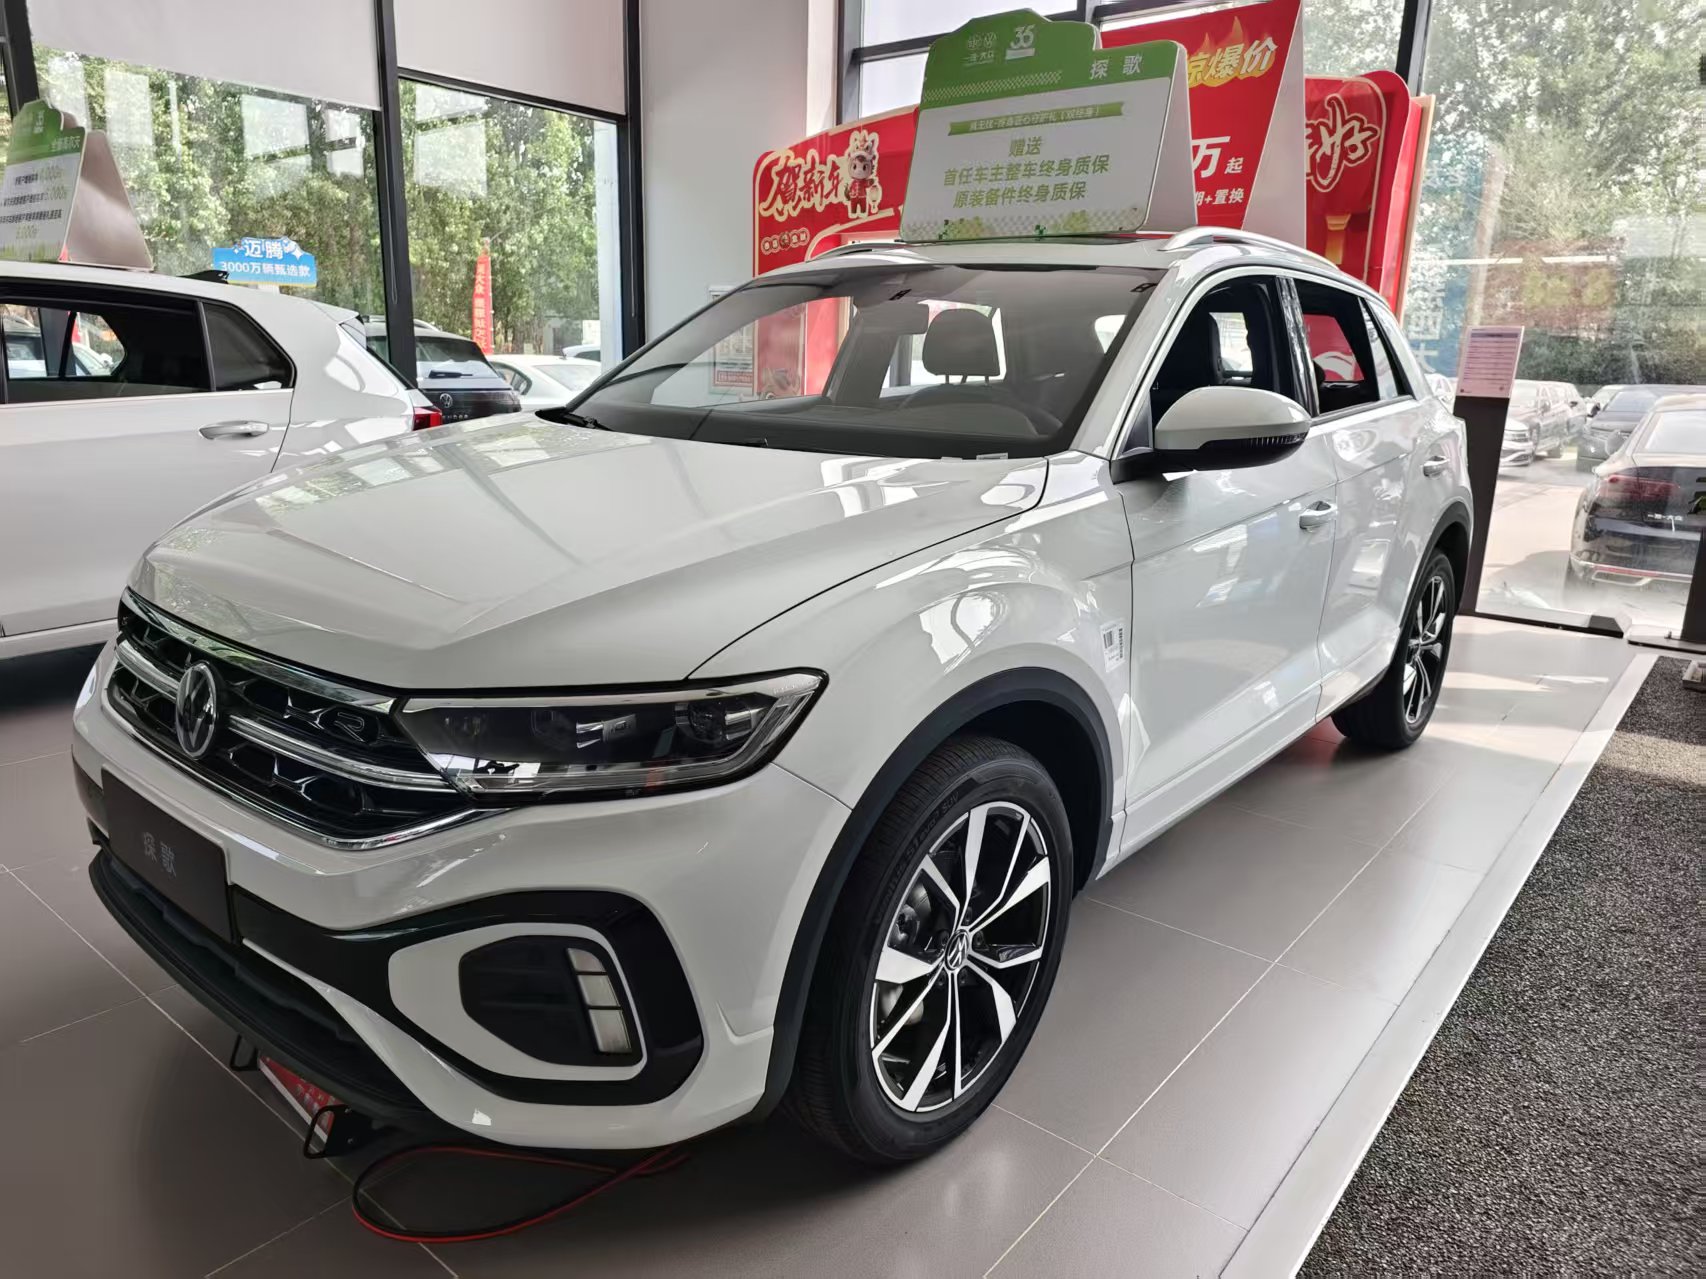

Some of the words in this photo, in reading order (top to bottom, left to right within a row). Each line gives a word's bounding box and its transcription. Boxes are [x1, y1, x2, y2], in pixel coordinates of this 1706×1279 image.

[1090, 54, 1143, 80] 探歌
[1008, 136, 1042, 157] 赠送
[943, 154, 1110, 186] 首任车主整车终身质保
[953, 181, 1086, 208] 原装备件终身质保
[244, 239, 283, 259] 迈腾
